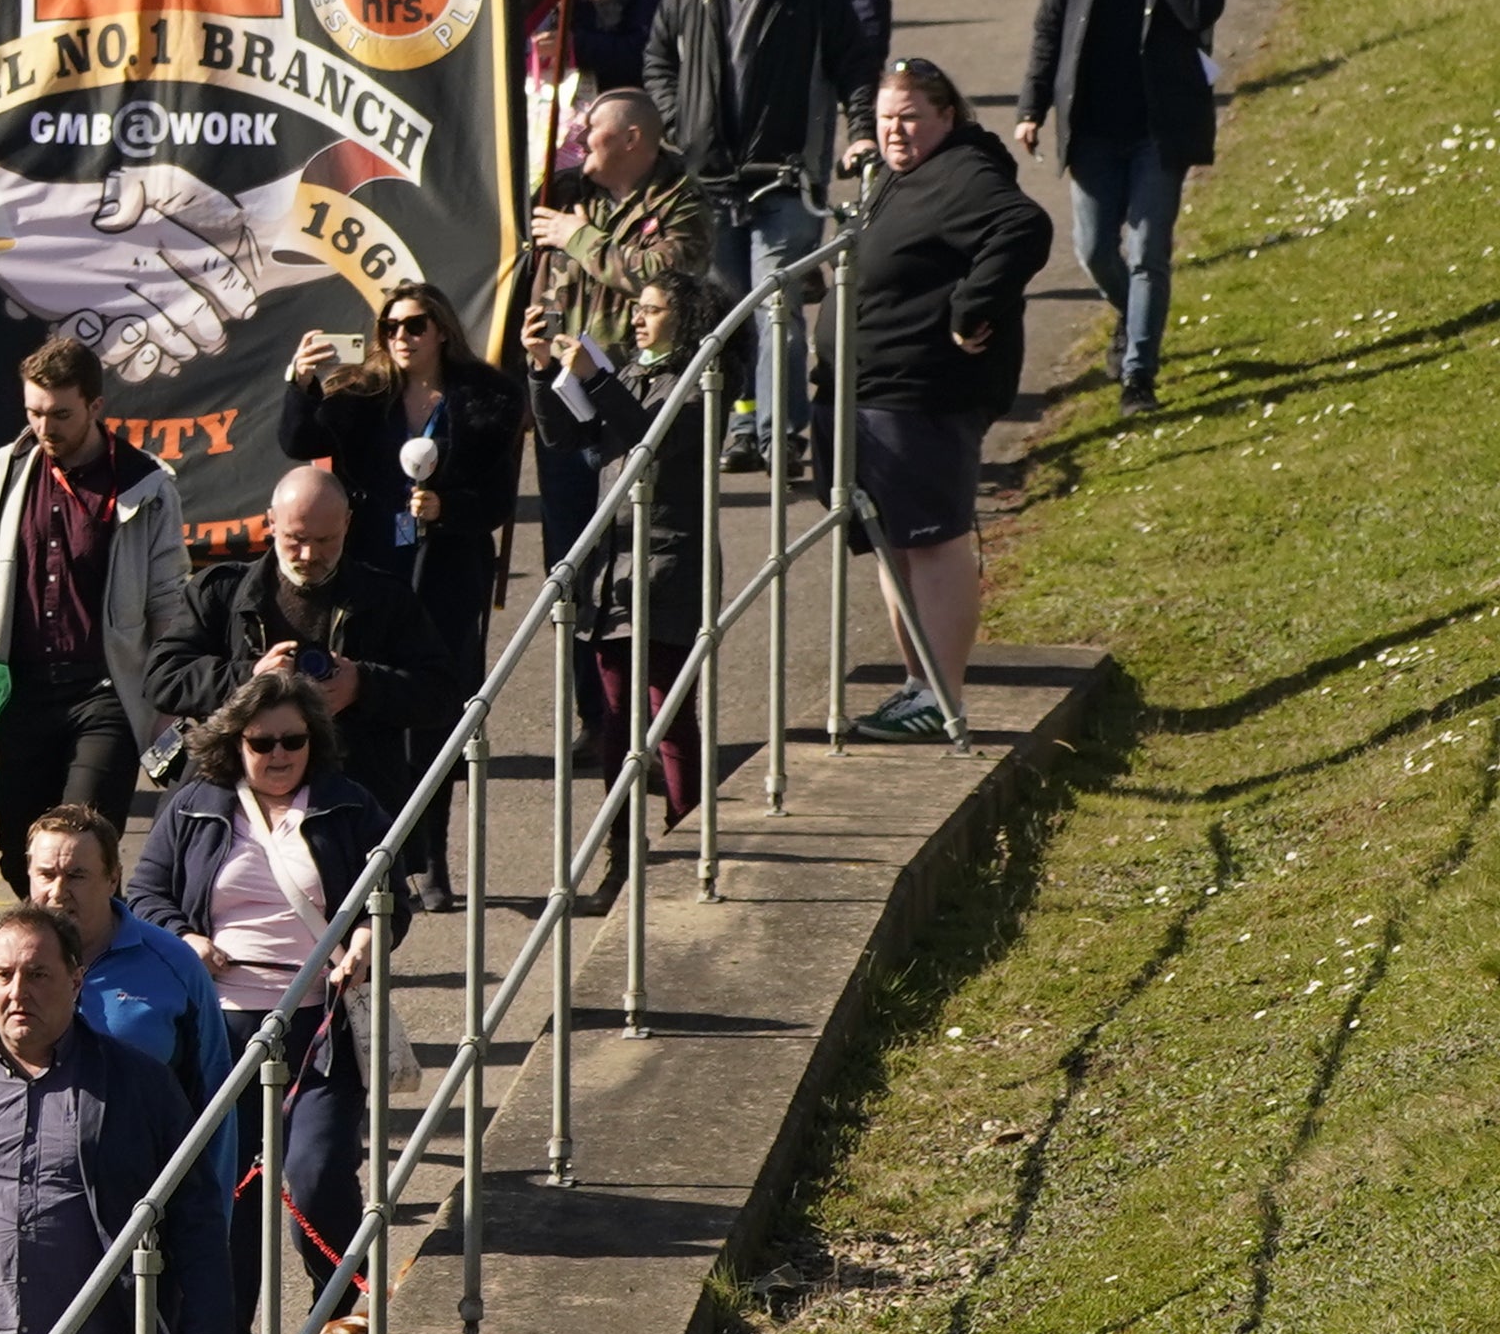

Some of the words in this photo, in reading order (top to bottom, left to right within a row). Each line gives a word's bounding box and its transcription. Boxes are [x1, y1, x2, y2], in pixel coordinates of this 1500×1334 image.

[29, 101, 279, 159] GMB@WORK
[198, 21, 426, 170] BRANCH
[299, 200, 407, 294] 186
